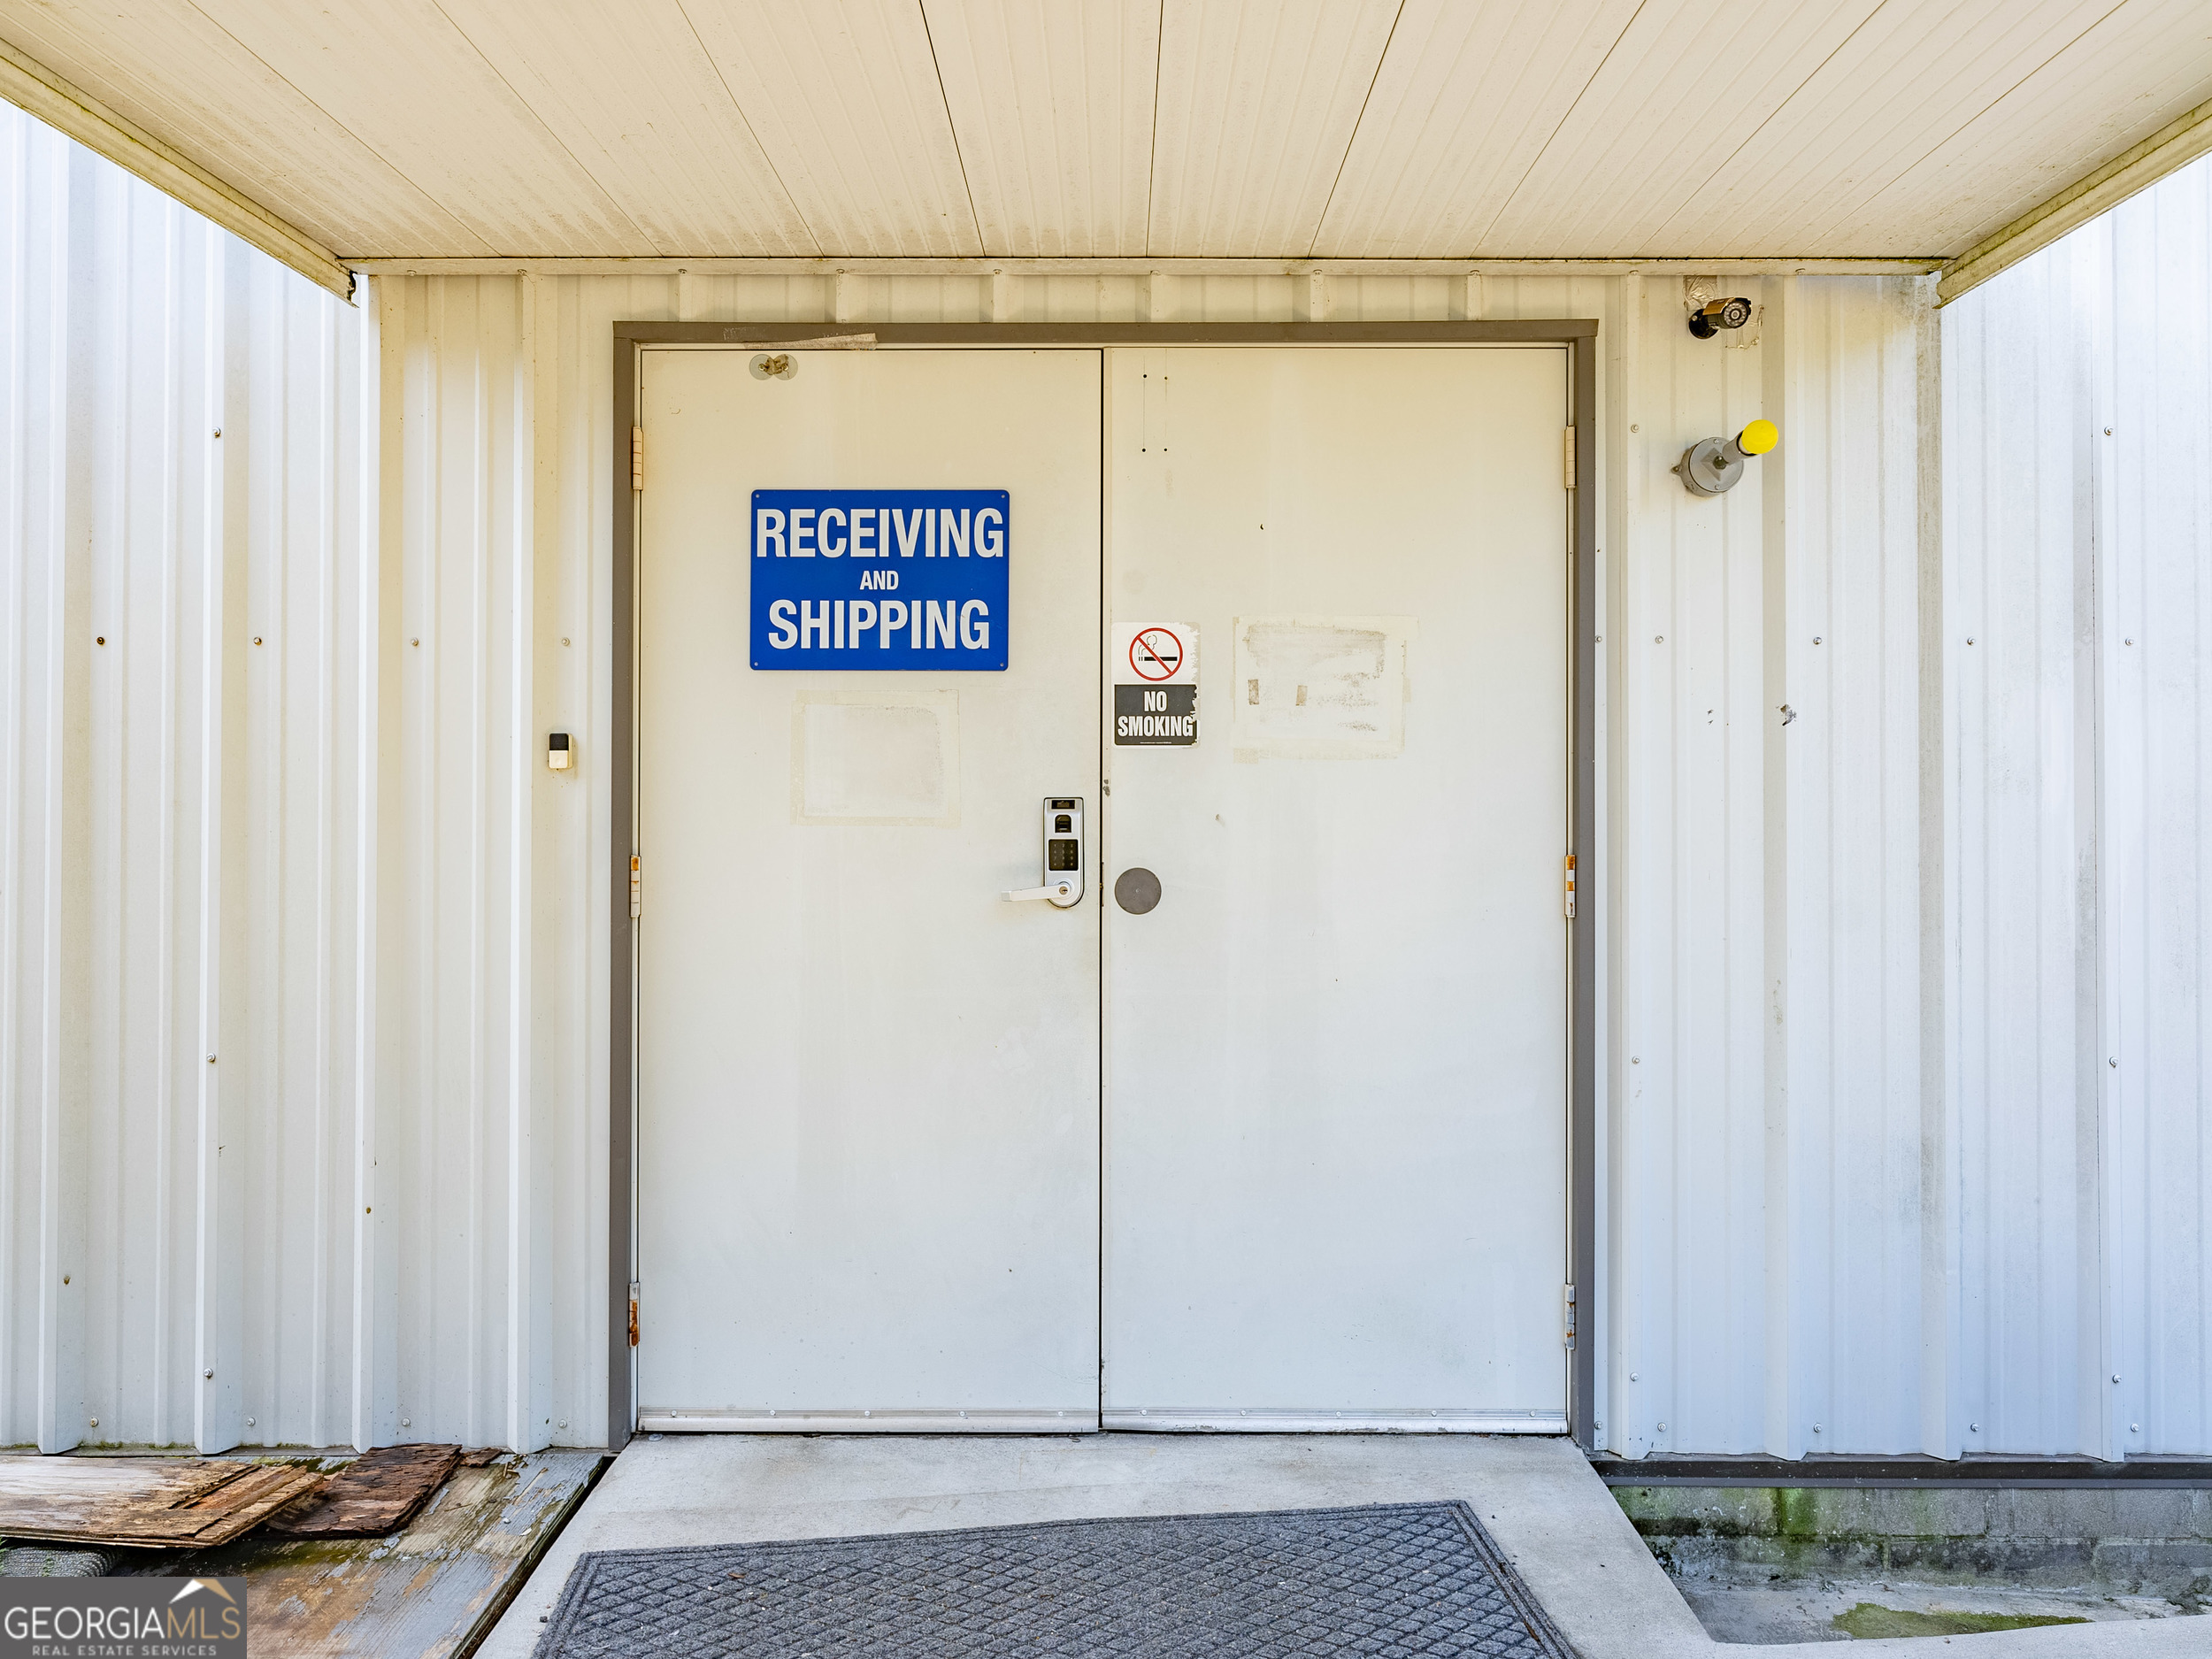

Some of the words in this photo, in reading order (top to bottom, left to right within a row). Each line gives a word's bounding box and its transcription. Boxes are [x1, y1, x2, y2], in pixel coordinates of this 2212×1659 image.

[757, 508, 1003, 558] RECEIVING
[859, 570, 899, 590] AND
[768, 598, 989, 650] SHIPPING
[1144, 691, 1168, 712] NO
[1118, 715, 1194, 737] SMOKING
